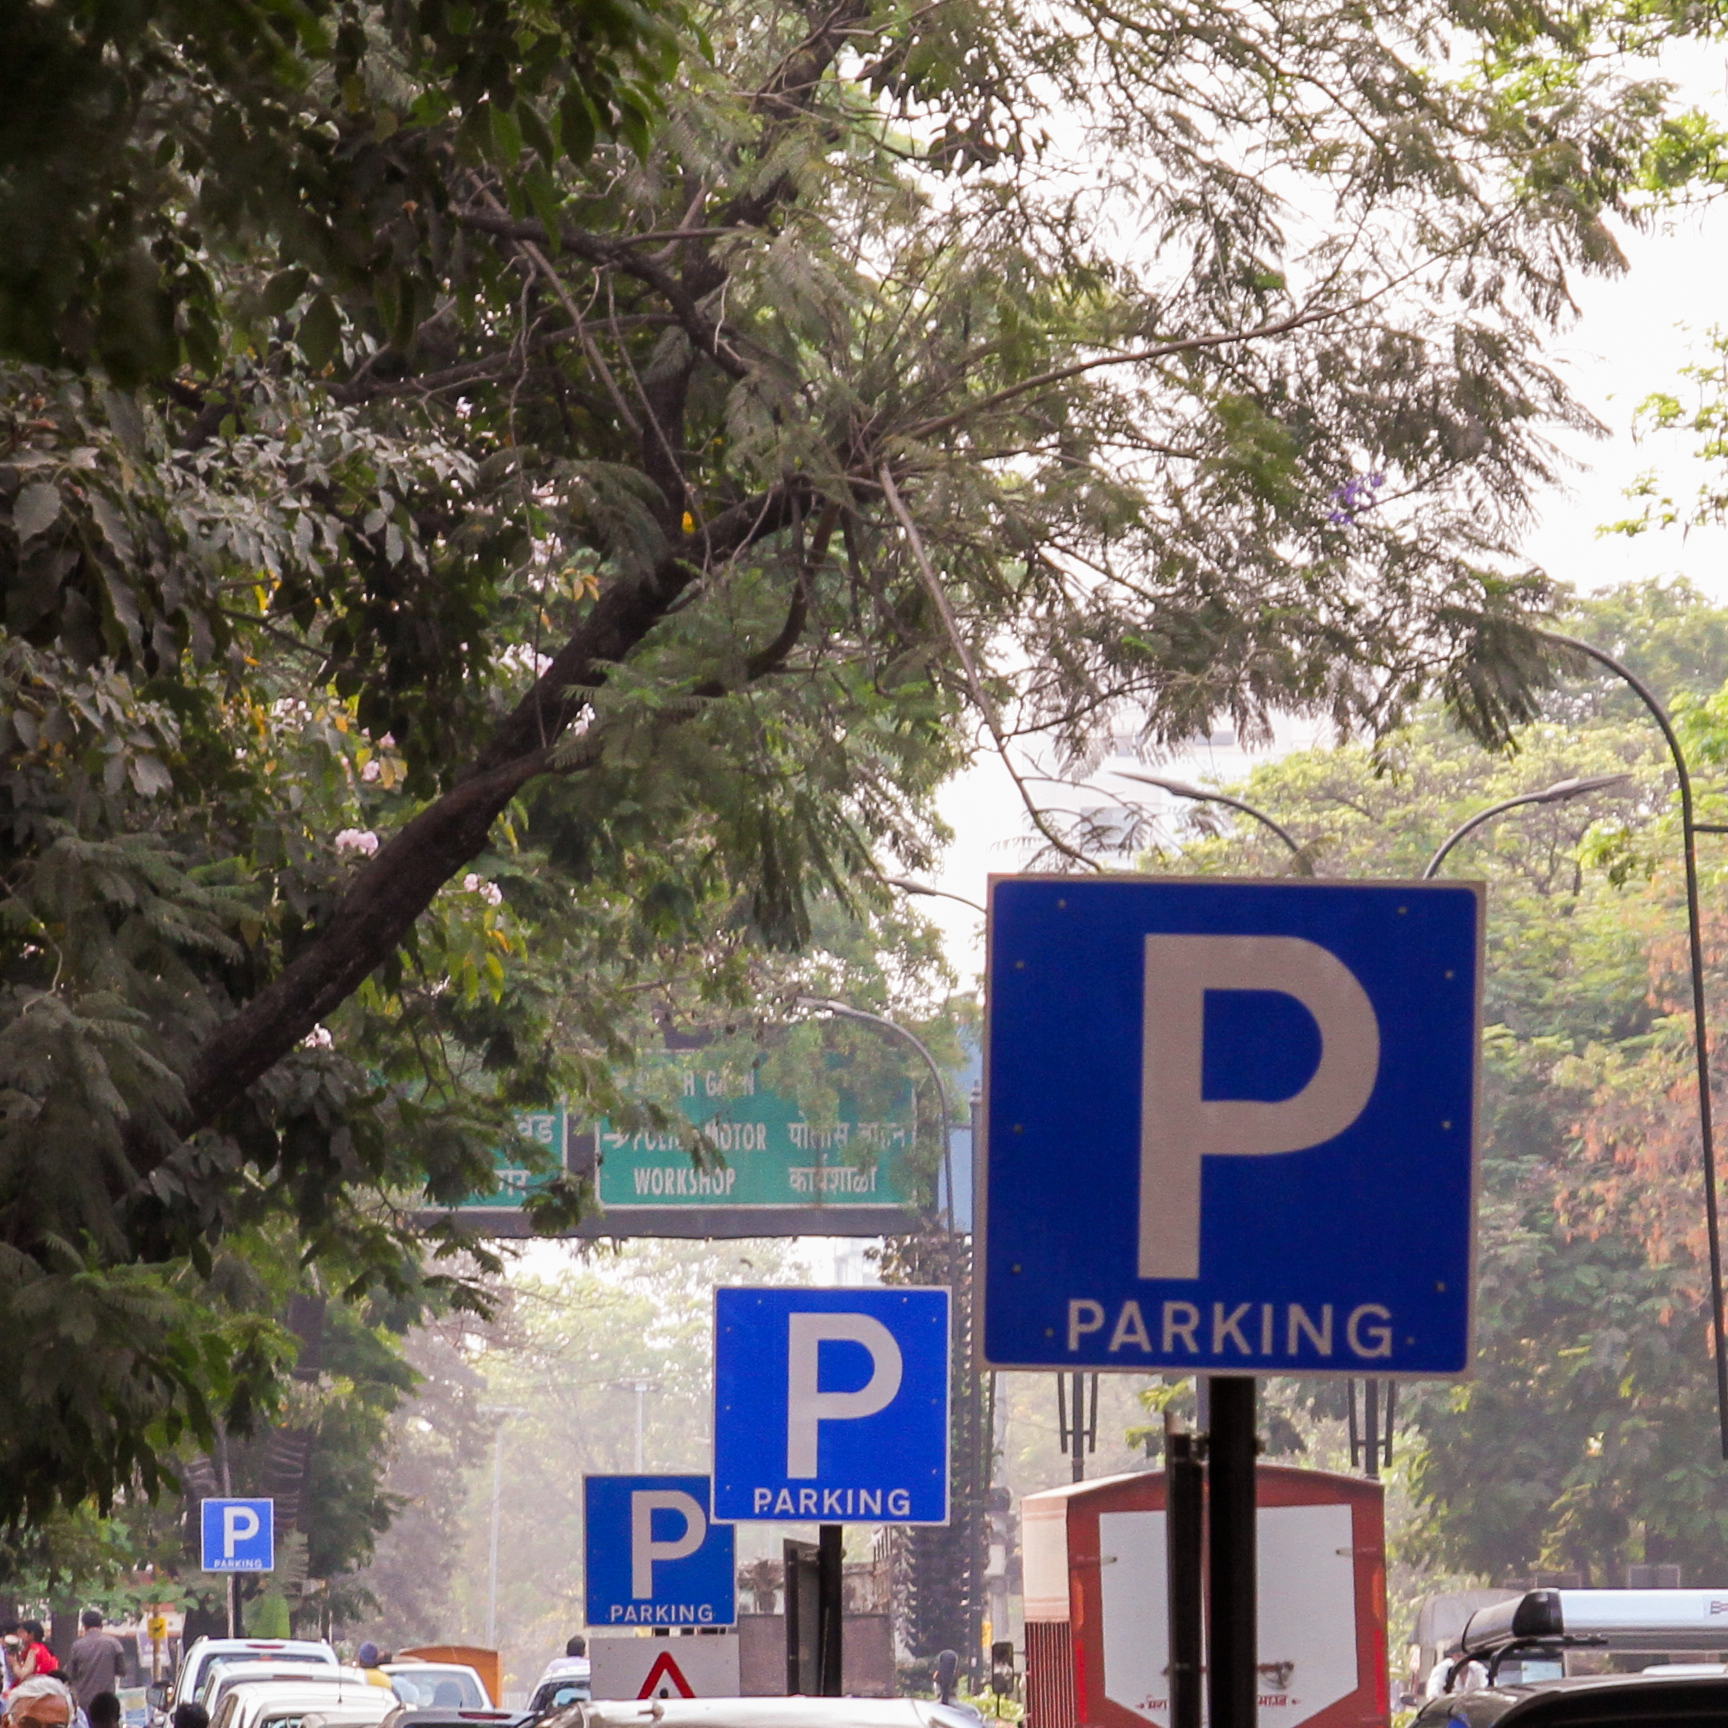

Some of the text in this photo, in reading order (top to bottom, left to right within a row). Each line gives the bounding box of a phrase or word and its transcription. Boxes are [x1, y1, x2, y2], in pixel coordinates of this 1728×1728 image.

[1138, 933, 1381, 1279] P
[633, 1167, 737, 1196] WORKSHOP
[1068, 1299, 1393, 1358] PARKING
[787, 1312, 903, 1479] P
[754, 1487, 910, 1516] PARKING
[223, 1506, 260, 1558] P
[631, 1490, 707, 1600] P
[214, 1558, 263, 1568] PARKING
[610, 1604, 713, 1622] PARKING
